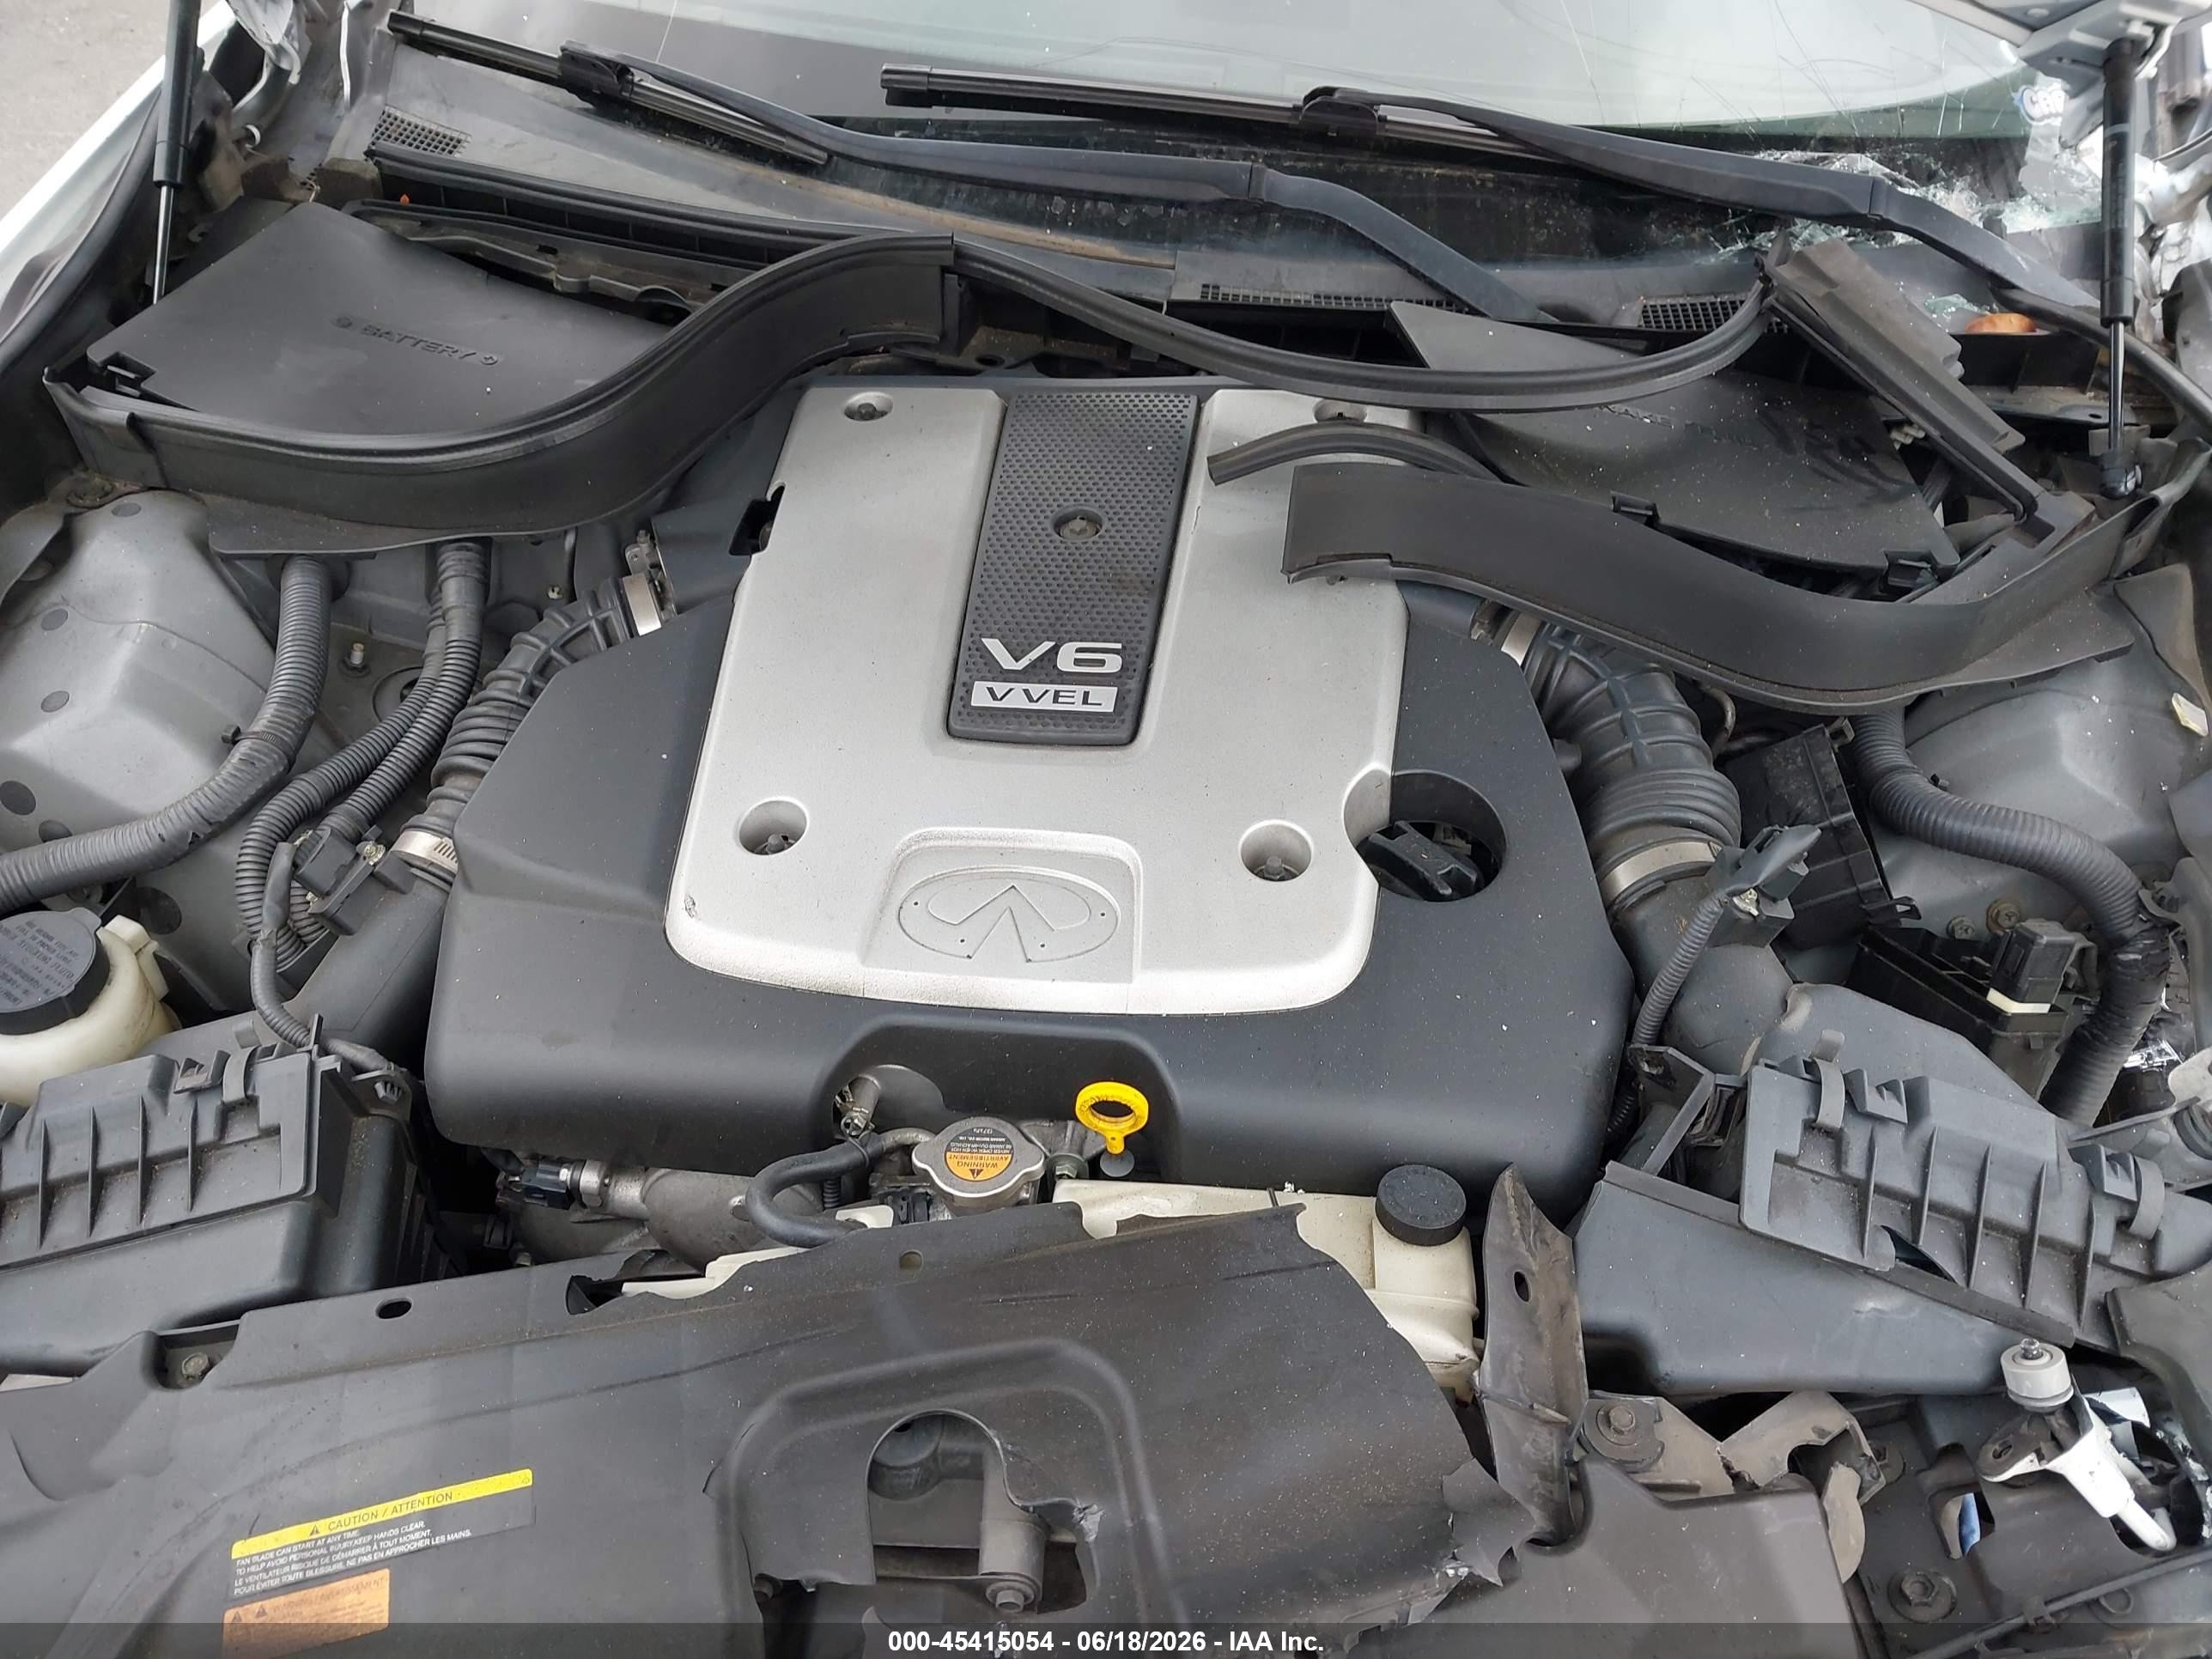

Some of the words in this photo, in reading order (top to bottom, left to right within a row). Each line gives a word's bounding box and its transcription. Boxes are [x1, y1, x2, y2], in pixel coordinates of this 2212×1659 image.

[361, 325, 477, 360] BATTERY
[981, 637, 1123, 674] V6
[328, 1511, 378, 1531] CAUTION
[391, 1492, 453, 1514] ATTENTION
[234, 1585, 256, 1595] POUR
[281, 1571, 305, 1583] TOUTE
[357, 1553, 373, 1565] PAS
[384, 1538, 430, 1558] APPROCHER
[430, 1534, 447, 1546] LES
[446, 1528, 472, 1542] MAINS.
[236, 1558, 251, 1567] FAN
[252, 1552, 275, 1563] BLADE
[276, 1547, 292, 1557] CAN
[292, 1540, 316, 1553] START
[326, 1534, 343, 1545] ANY
[244, 1565, 291, 1584] VENTILATEUR
[379, 1538, 398, 1549] TOUT
[398, 1528, 432, 1544] MOMENT.
[246, 1562, 267, 1573] HELP
[266, 1557, 289, 1569] AVOID
[289, 1548, 328, 1563] PERSONAL
[373, 1528, 400, 1540] HANDS
[400, 1520, 426, 1534] CLEAR.
